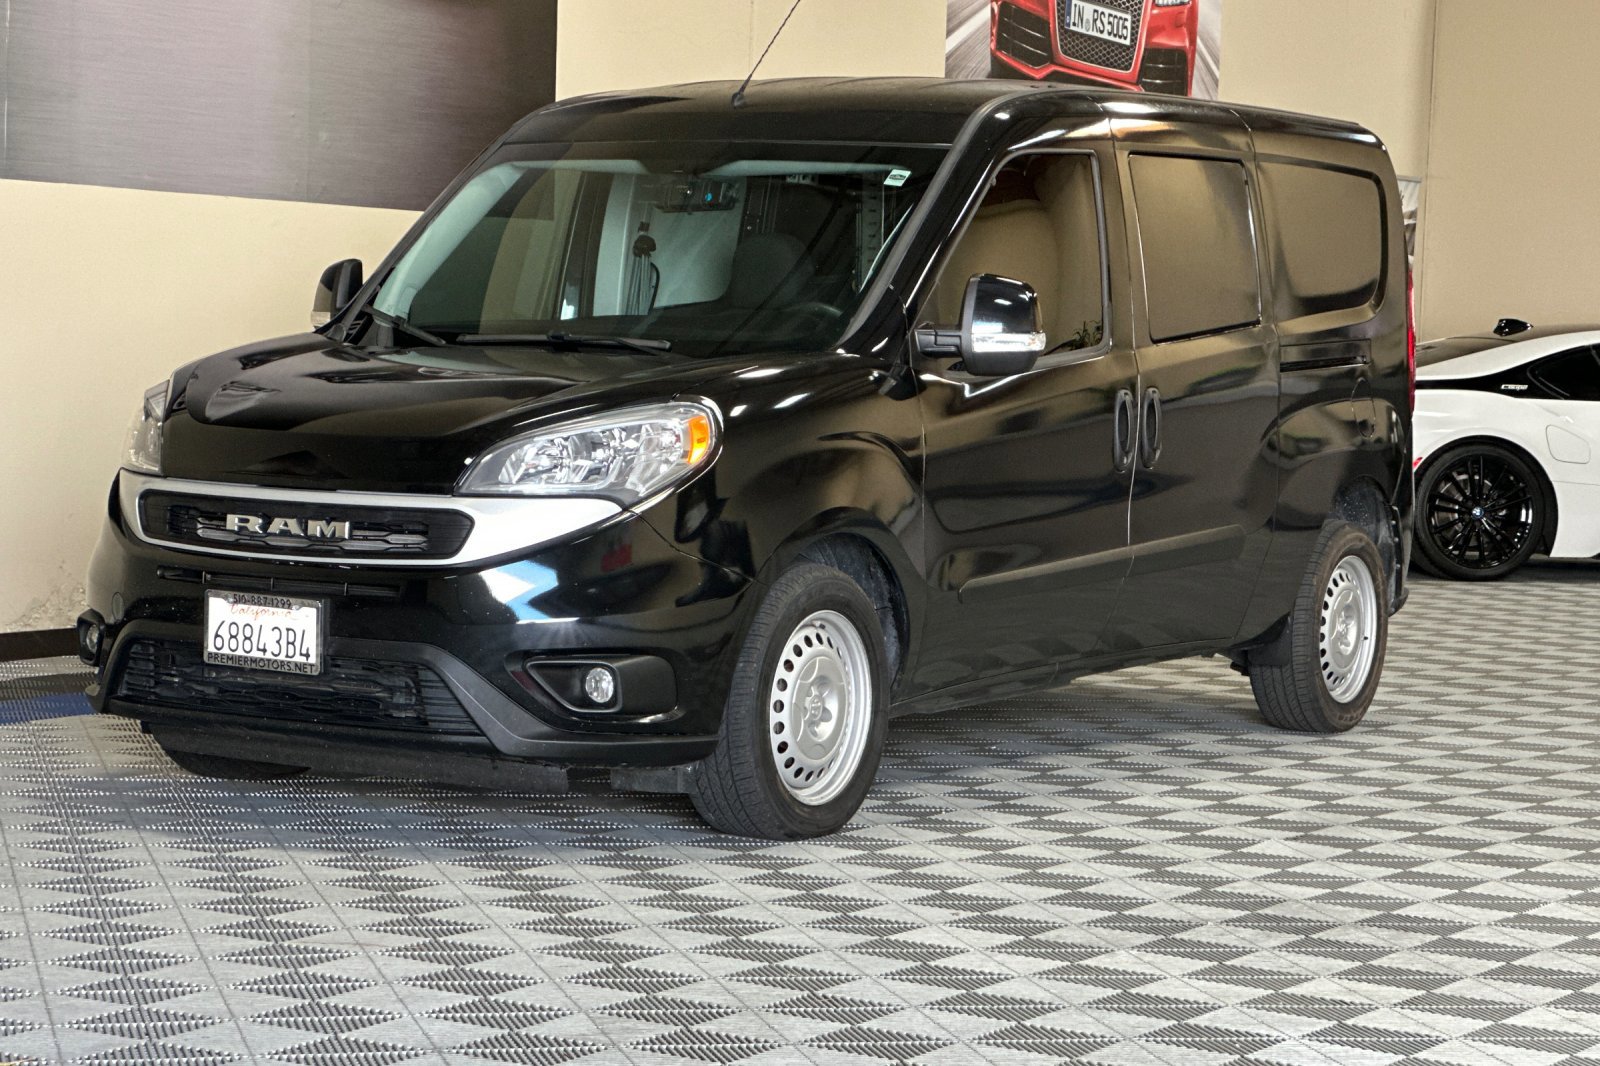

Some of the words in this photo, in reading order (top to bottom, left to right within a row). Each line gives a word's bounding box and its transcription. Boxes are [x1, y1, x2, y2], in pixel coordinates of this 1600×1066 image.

[1072, 3, 1084, 29] IN
[1092, 9, 1106, 34] RS
[226, 514, 350, 540] RAM
[231, 604, 292, 620] California
[233, 593, 292, 609] 510-887-1299
[213, 620, 311, 661] 68843B4
[207, 652, 315, 673] PREMIERMOTORS.NET
